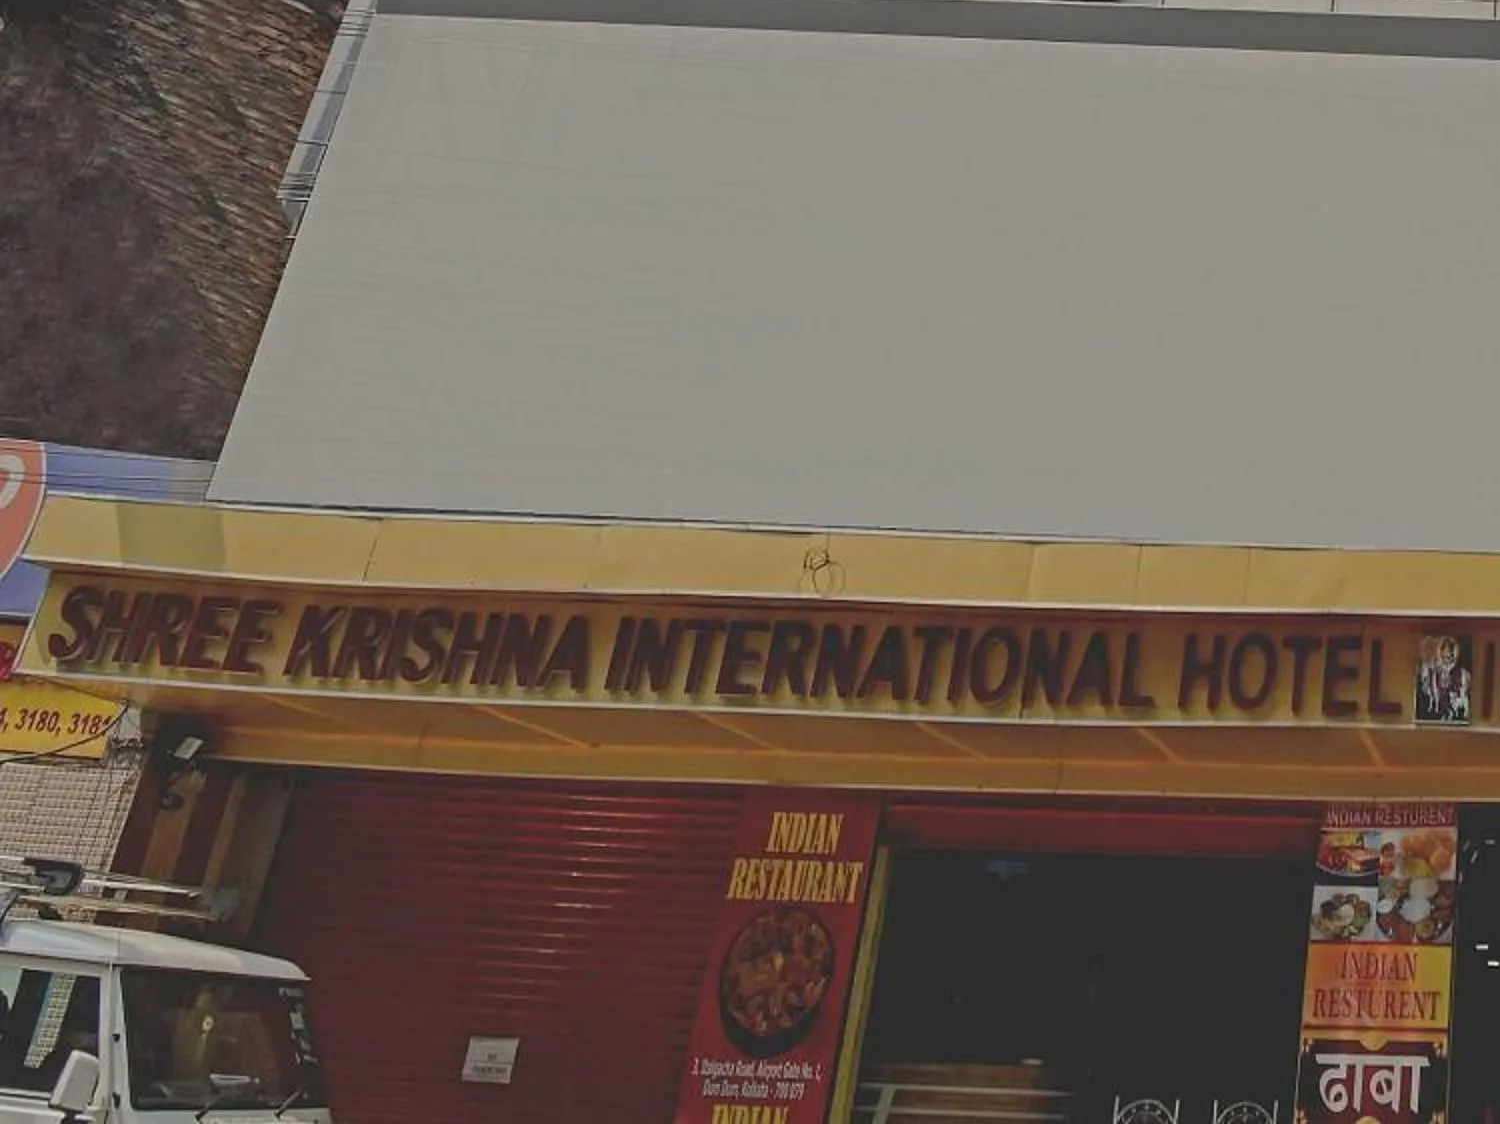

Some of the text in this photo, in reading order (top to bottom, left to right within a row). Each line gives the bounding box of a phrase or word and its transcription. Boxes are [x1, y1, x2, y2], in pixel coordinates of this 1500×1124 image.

[48, 584, 286, 676] SHREE
[283, 604, 592, 692] KRISHNA
[605, 615, 1156, 712] INTERNATIONAL
[1178, 631, 1404, 718] HOTEL
[765, 812, 844, 855] INDIAN
[1327, 804, 1371, 826] INDIAN
[726, 857, 864, 904] RESTAURANT
[1341, 951, 1418, 982] INDIAN
[1312, 988, 1440, 1021] RESTURENT
[1315, 1053, 1431, 1114] ढाबा
